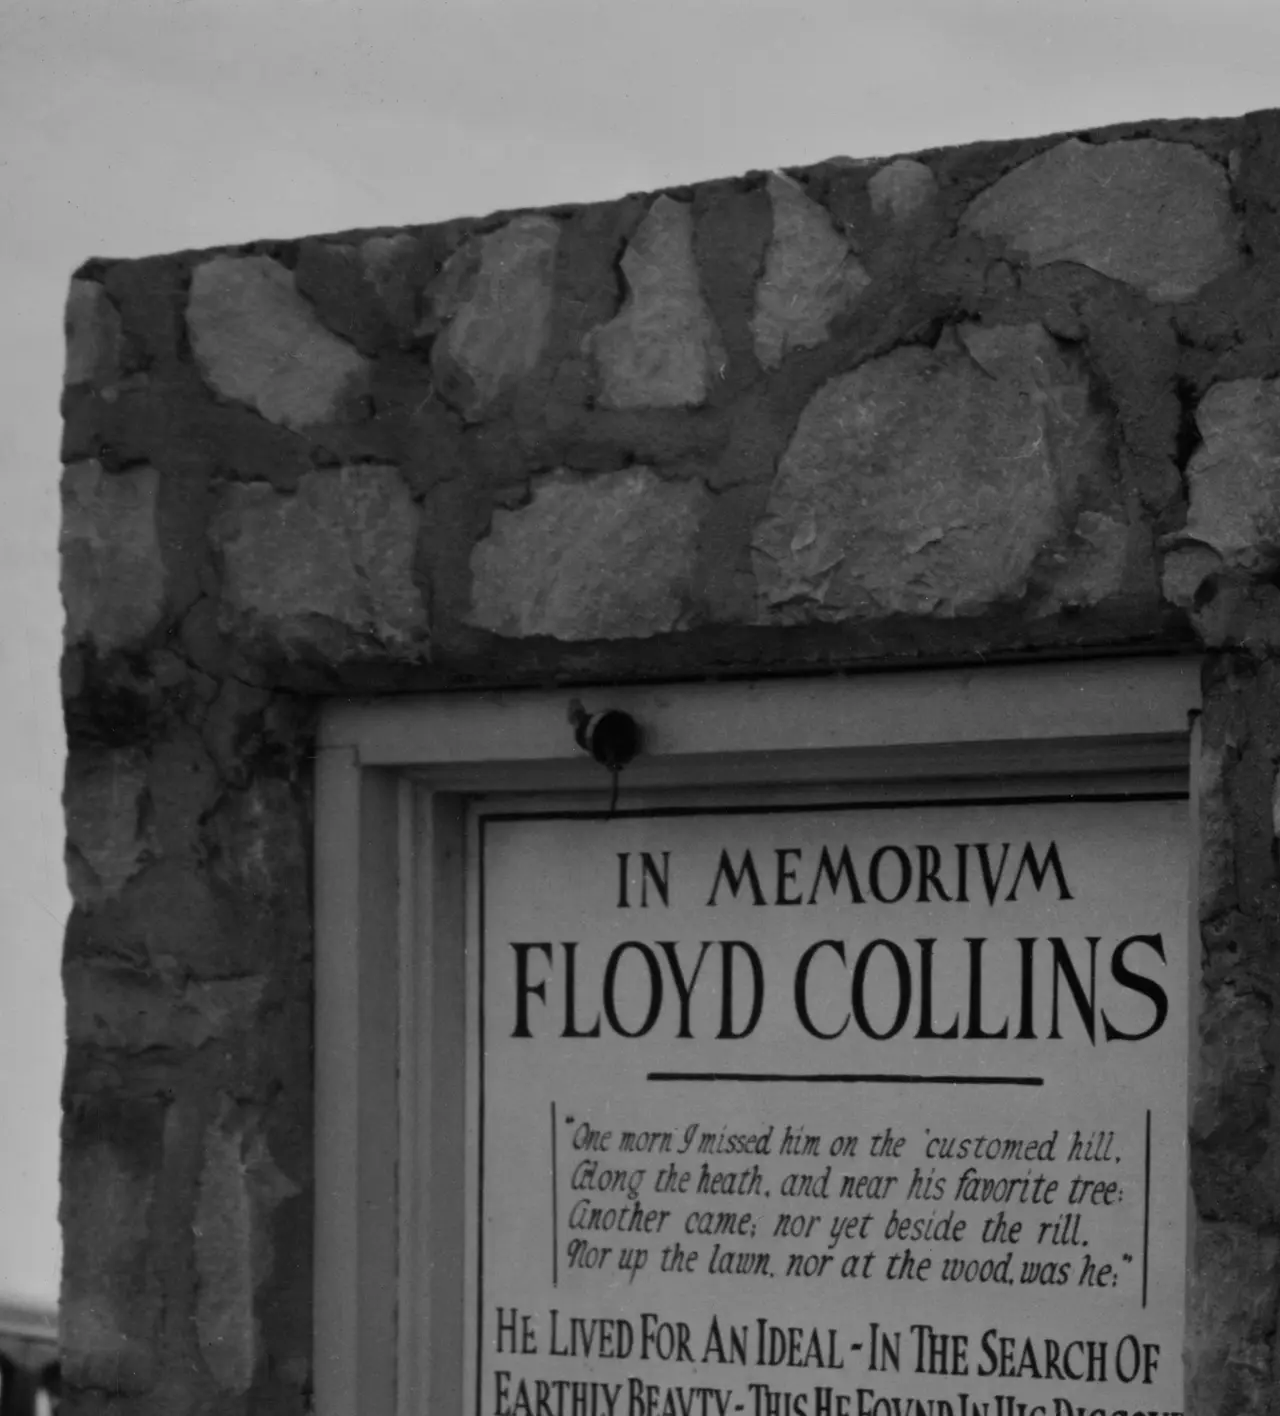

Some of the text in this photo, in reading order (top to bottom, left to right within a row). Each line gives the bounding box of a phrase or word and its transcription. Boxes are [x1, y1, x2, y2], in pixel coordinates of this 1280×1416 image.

[618, 841, 1074, 908] IN MEMORIVM
[510, 933, 1168, 1046] FLOYD COLLINS
[620, 1132, 671, 1152] morn
[700, 1126, 771, 1155] missed
[780, 1126, 820, 1156] him
[830, 1137, 858, 1156] on
[871, 1128, 905, 1157] the
[572, 1160, 643, 1198] Along
[655, 1166, 689, 1192] the
[781, 1169, 831, 1198] and
[840, 1177, 897, 1199] near
[908, 1171, 945, 1200] his
[955, 1170, 1058, 1204] favorite
[569, 1200, 670, 1232] Another
[774, 1214, 820, 1237] nor
[829, 1214, 870, 1247] yet
[885, 1211, 966, 1241] beside
[983, 1214, 1021, 1243] the
[568, 1239, 611, 1268] Nor
[619, 1249, 647, 1283] up
[661, 1243, 697, 1272] the
[786, 1255, 833, 1276] nor
[842, 1252, 875, 1278] at
[887, 1249, 929, 1281] the
[1021, 1262, 1070, 1285] was
[497, 1307, 537, 1354] HE
[550, 1310, 633, 1358] LIVED
[641, 1314, 694, 1362] FOR
[701, 1315, 748, 1365] AN
[756, 1319, 843, 1368] IDEAL
[869, 1323, 900, 1371] IN
[911, 1325, 968, 1375] THE
[978, 1329, 1107, 1381] SEARCH
[1116, 1335, 1160, 1384] OF
